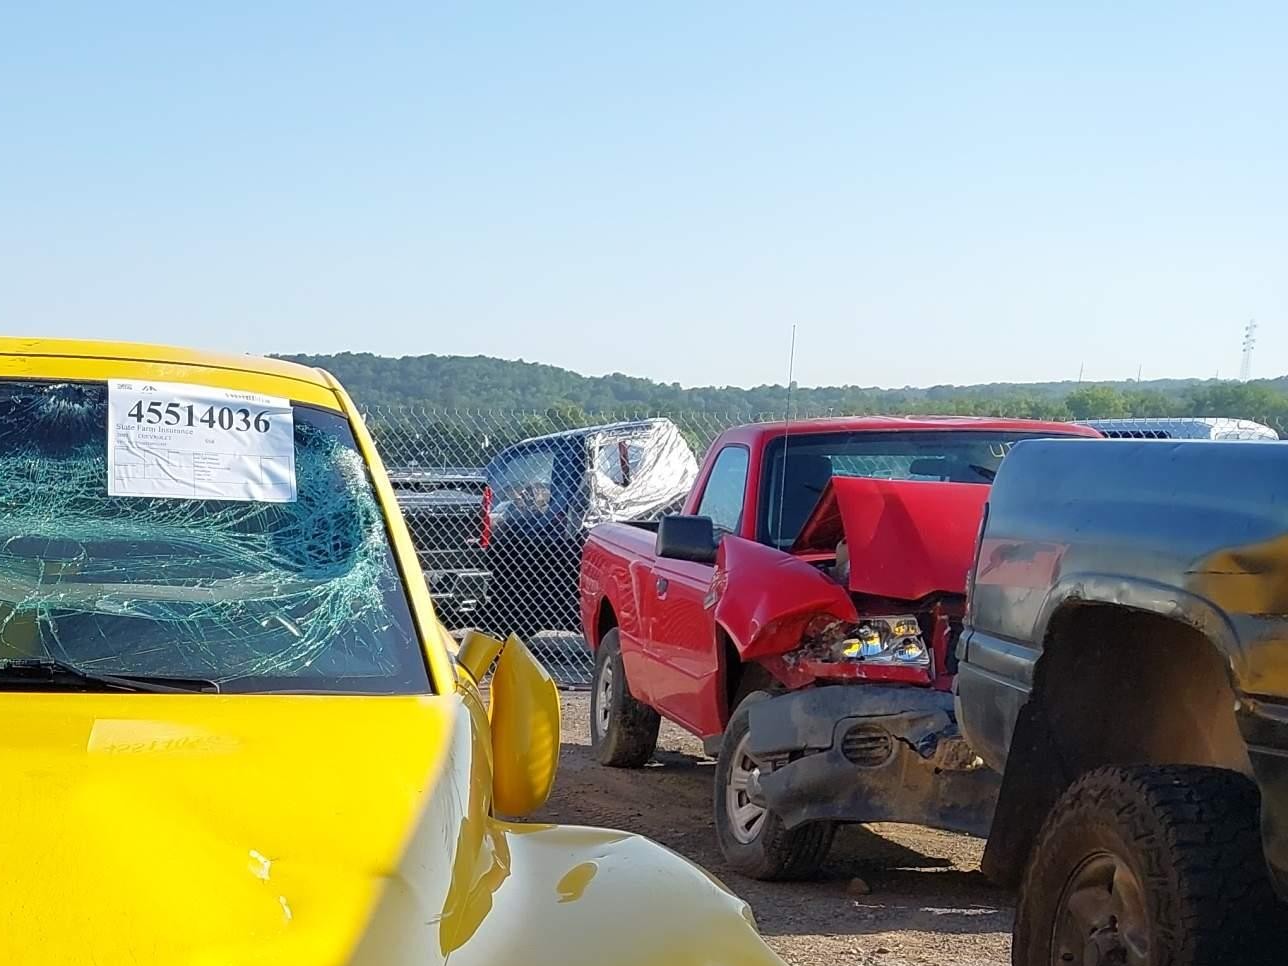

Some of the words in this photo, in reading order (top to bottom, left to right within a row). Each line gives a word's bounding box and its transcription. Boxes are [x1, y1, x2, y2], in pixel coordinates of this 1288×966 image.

[128, 400, 271, 433] 45514036
[116, 423, 135, 431] State
[137, 424, 156, 433] Farm
[158, 426, 194, 435] Insurance
